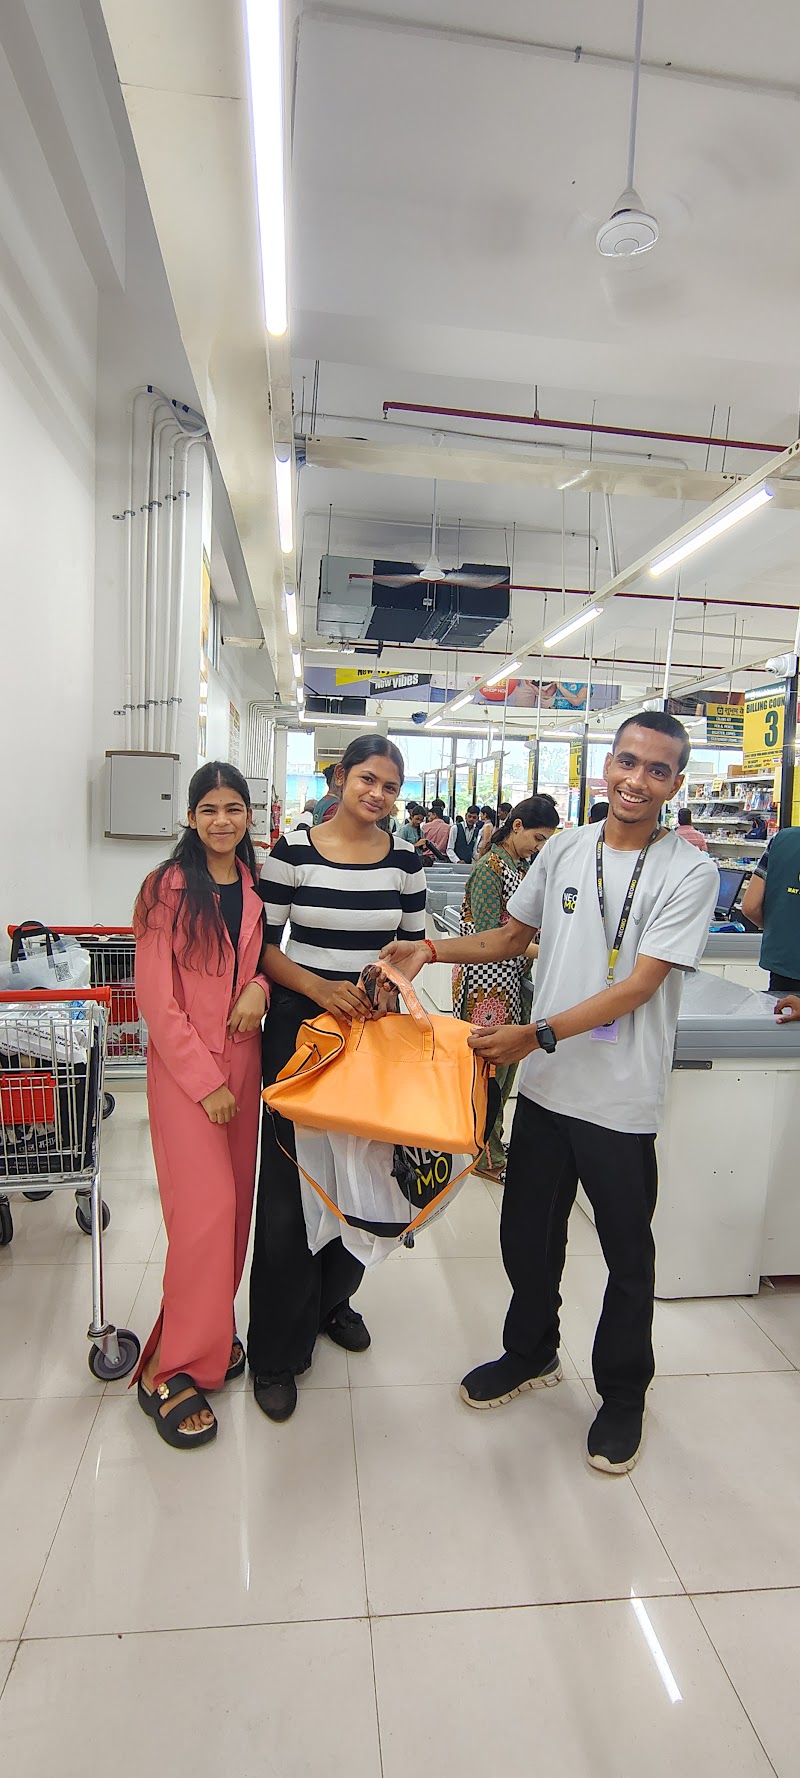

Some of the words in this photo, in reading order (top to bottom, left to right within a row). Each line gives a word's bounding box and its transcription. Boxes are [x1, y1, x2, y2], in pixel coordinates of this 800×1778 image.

[746, 700, 768, 714] BILLING
[765, 710, 778, 747] 3
[563, 892, 579, 903] NEO
[628, 879, 637, 899] NEOMO
[564, 901, 577, 911] MO
[618, 918, 627, 938] NEOMO
[415, 1156, 448, 1195] MO
